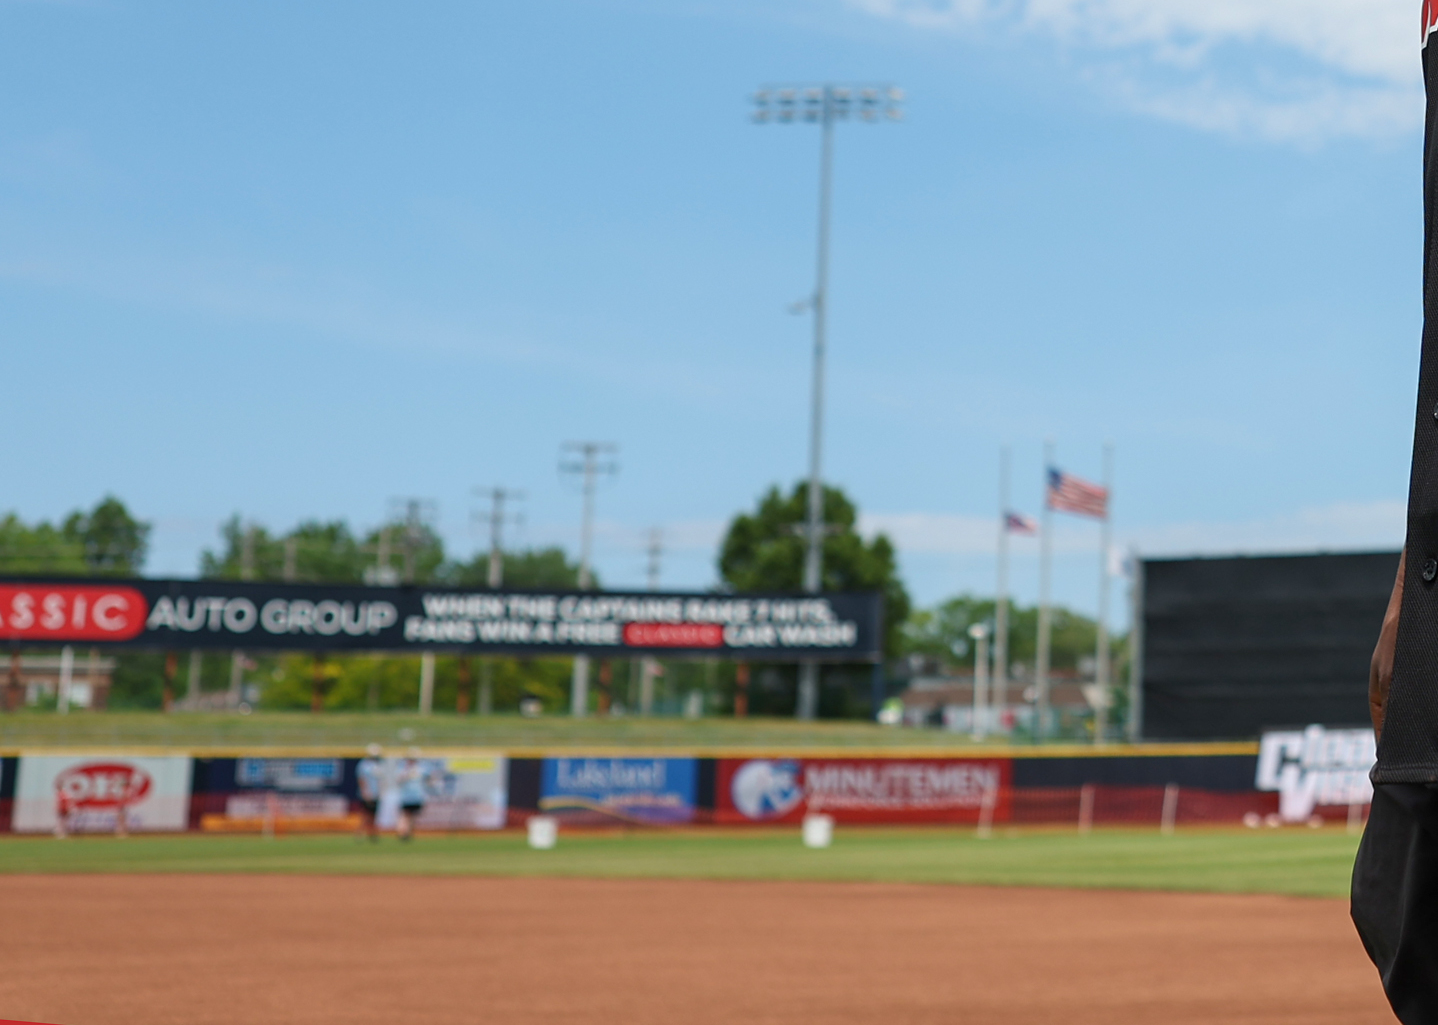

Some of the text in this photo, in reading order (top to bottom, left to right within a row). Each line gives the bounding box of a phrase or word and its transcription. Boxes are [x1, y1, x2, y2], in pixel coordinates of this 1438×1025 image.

[0, 592, 398, 636] SSIC AUTO GROUP
[422, 593, 505, 618] WHEN
[507, 594, 556, 619] THE
[558, 595, 682, 622] CAPTAINS
[404, 616, 476, 642] FANS
[478, 618, 532, 643] WIN
[533, 619, 555, 643] A
[556, 620, 620, 645] FREE
[724, 623, 777, 647] CAR
[779, 621, 857, 647] WASH
[805, 764, 998, 797] MINUTEMEN
